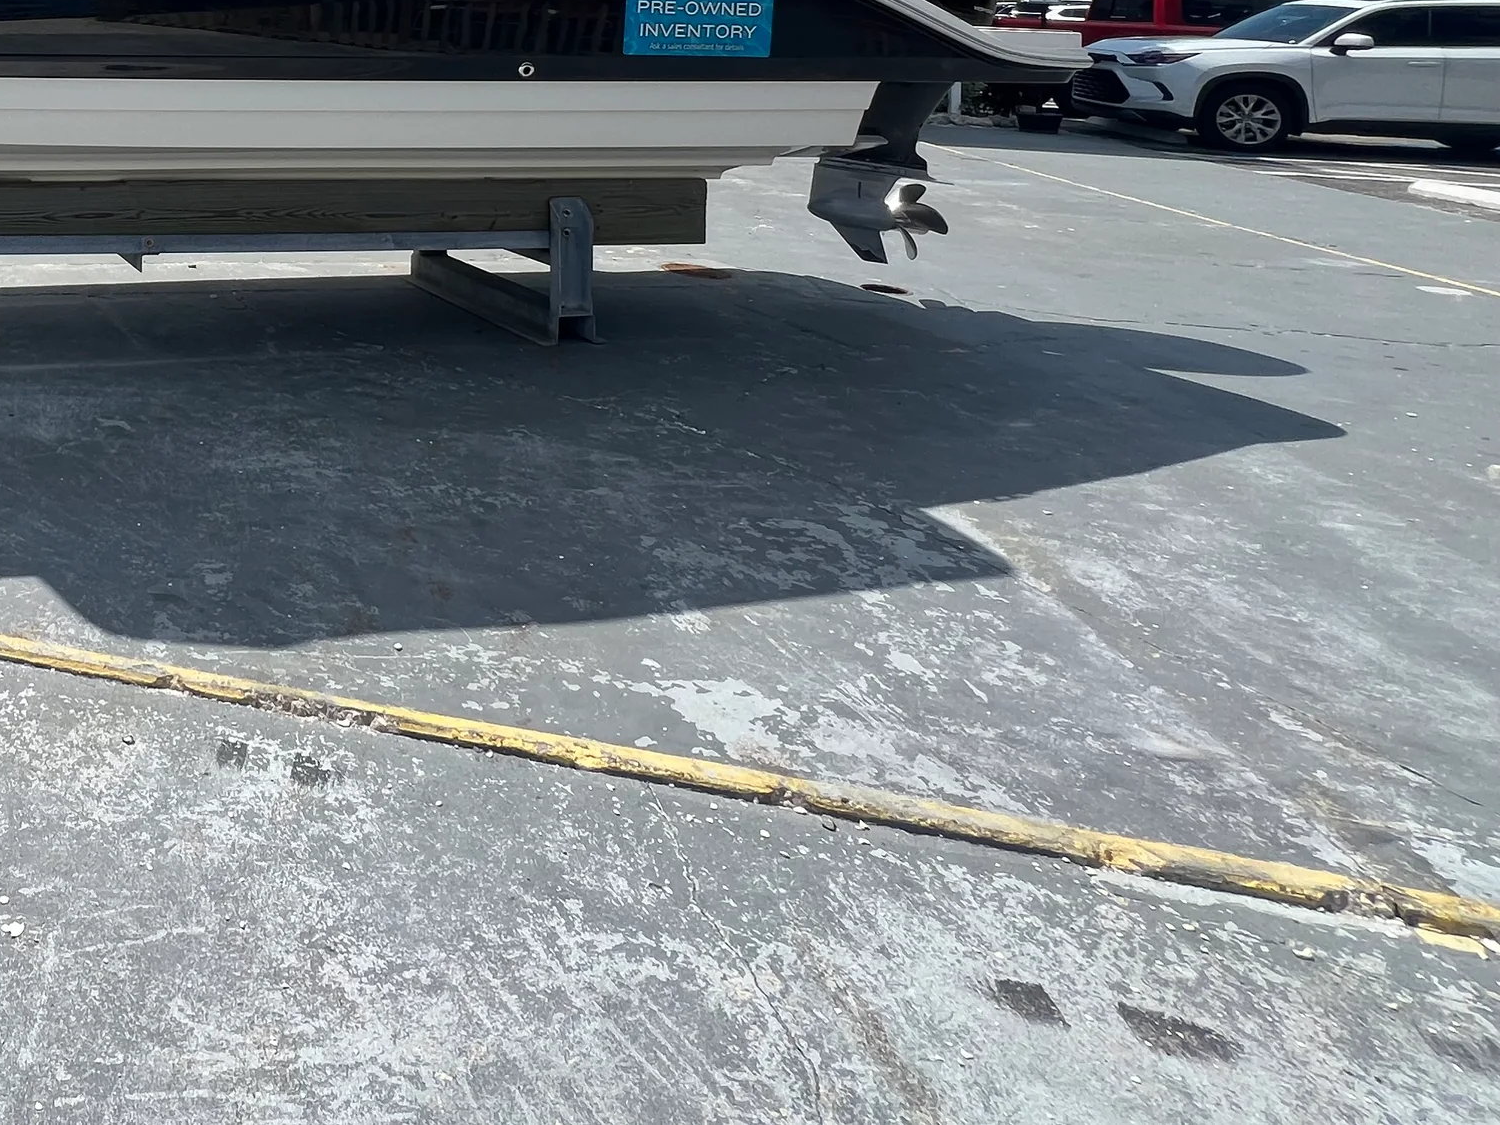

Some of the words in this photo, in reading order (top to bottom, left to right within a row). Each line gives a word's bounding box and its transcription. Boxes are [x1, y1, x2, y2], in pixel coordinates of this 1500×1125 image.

[637, 0, 762, 17] PRE-OWNED
[639, 23, 758, 39] INVENTORY
[649, 42, 660, 50] Ask
